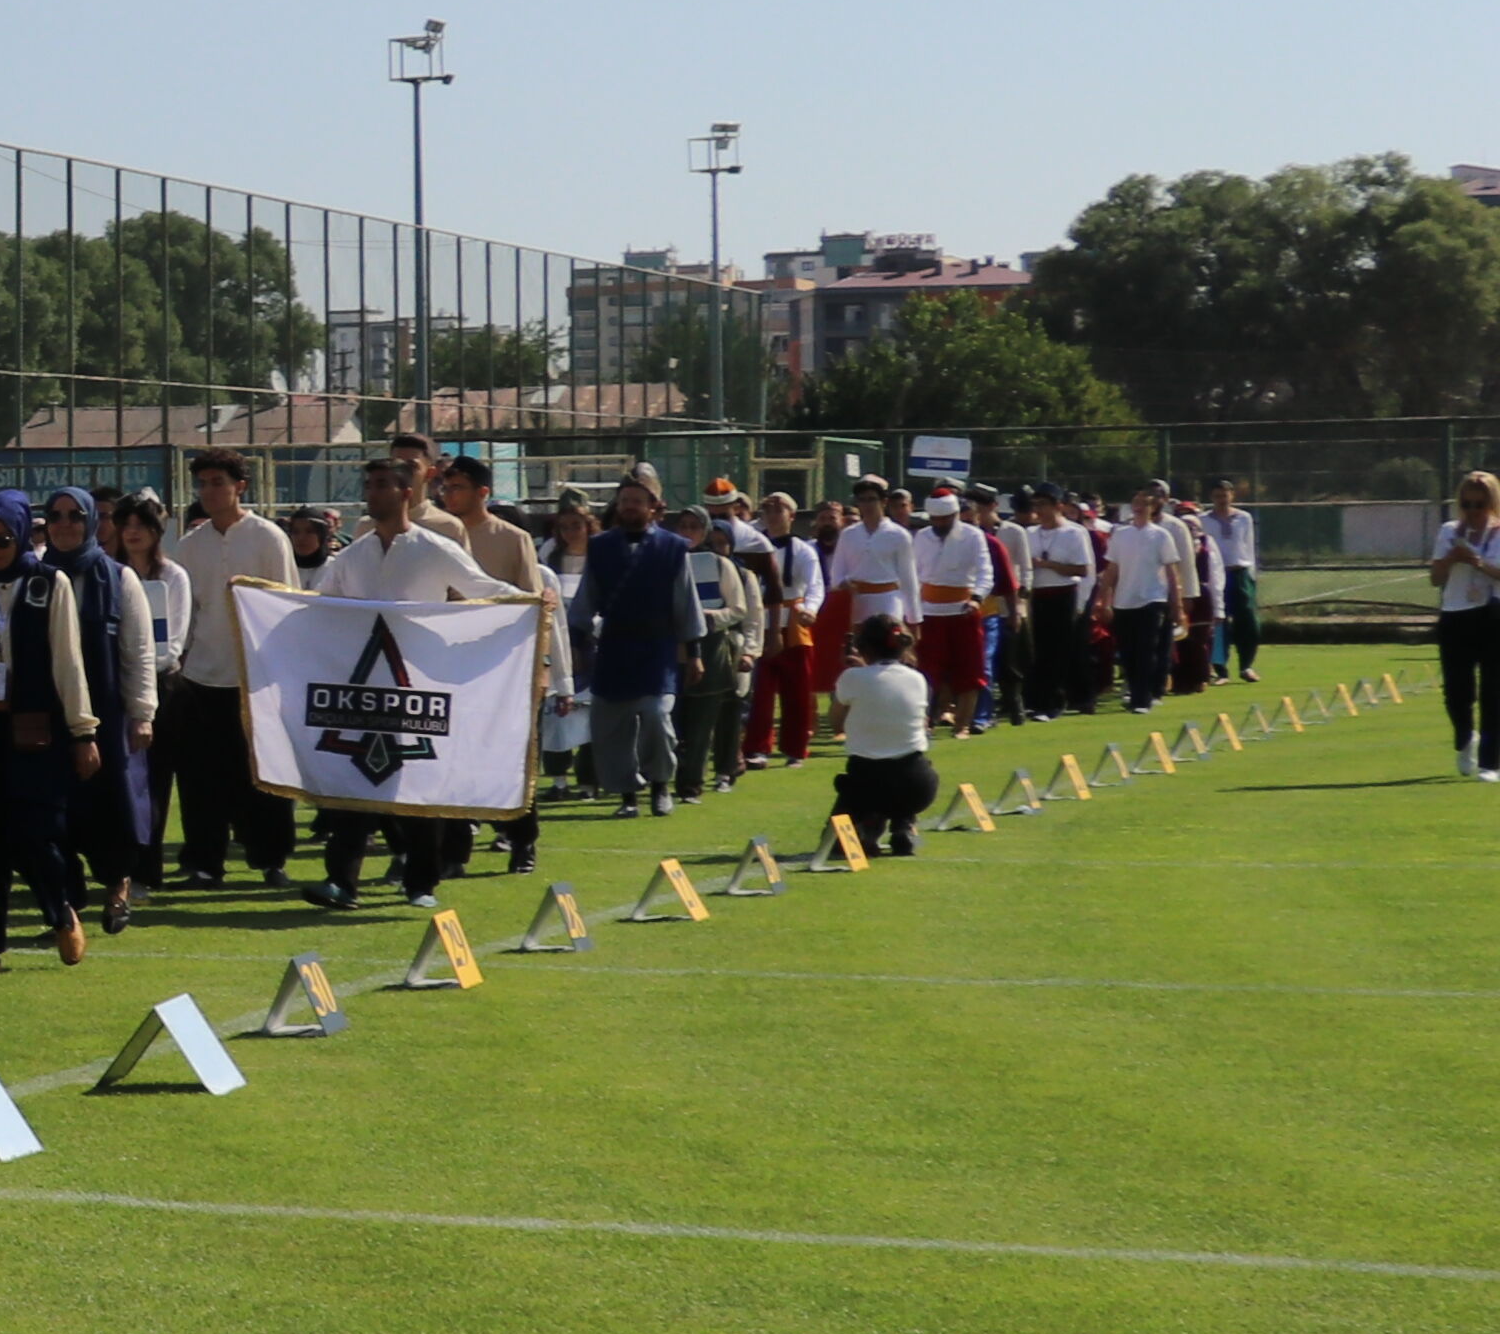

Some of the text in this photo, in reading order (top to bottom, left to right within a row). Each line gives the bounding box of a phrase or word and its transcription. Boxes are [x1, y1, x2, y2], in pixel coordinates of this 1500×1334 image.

[313, 688, 446, 717] OKSPOR
[401, 719, 448, 732] KULÜBÜ
[441, 919, 469, 968] 29
[301, 961, 338, 1017] 30
